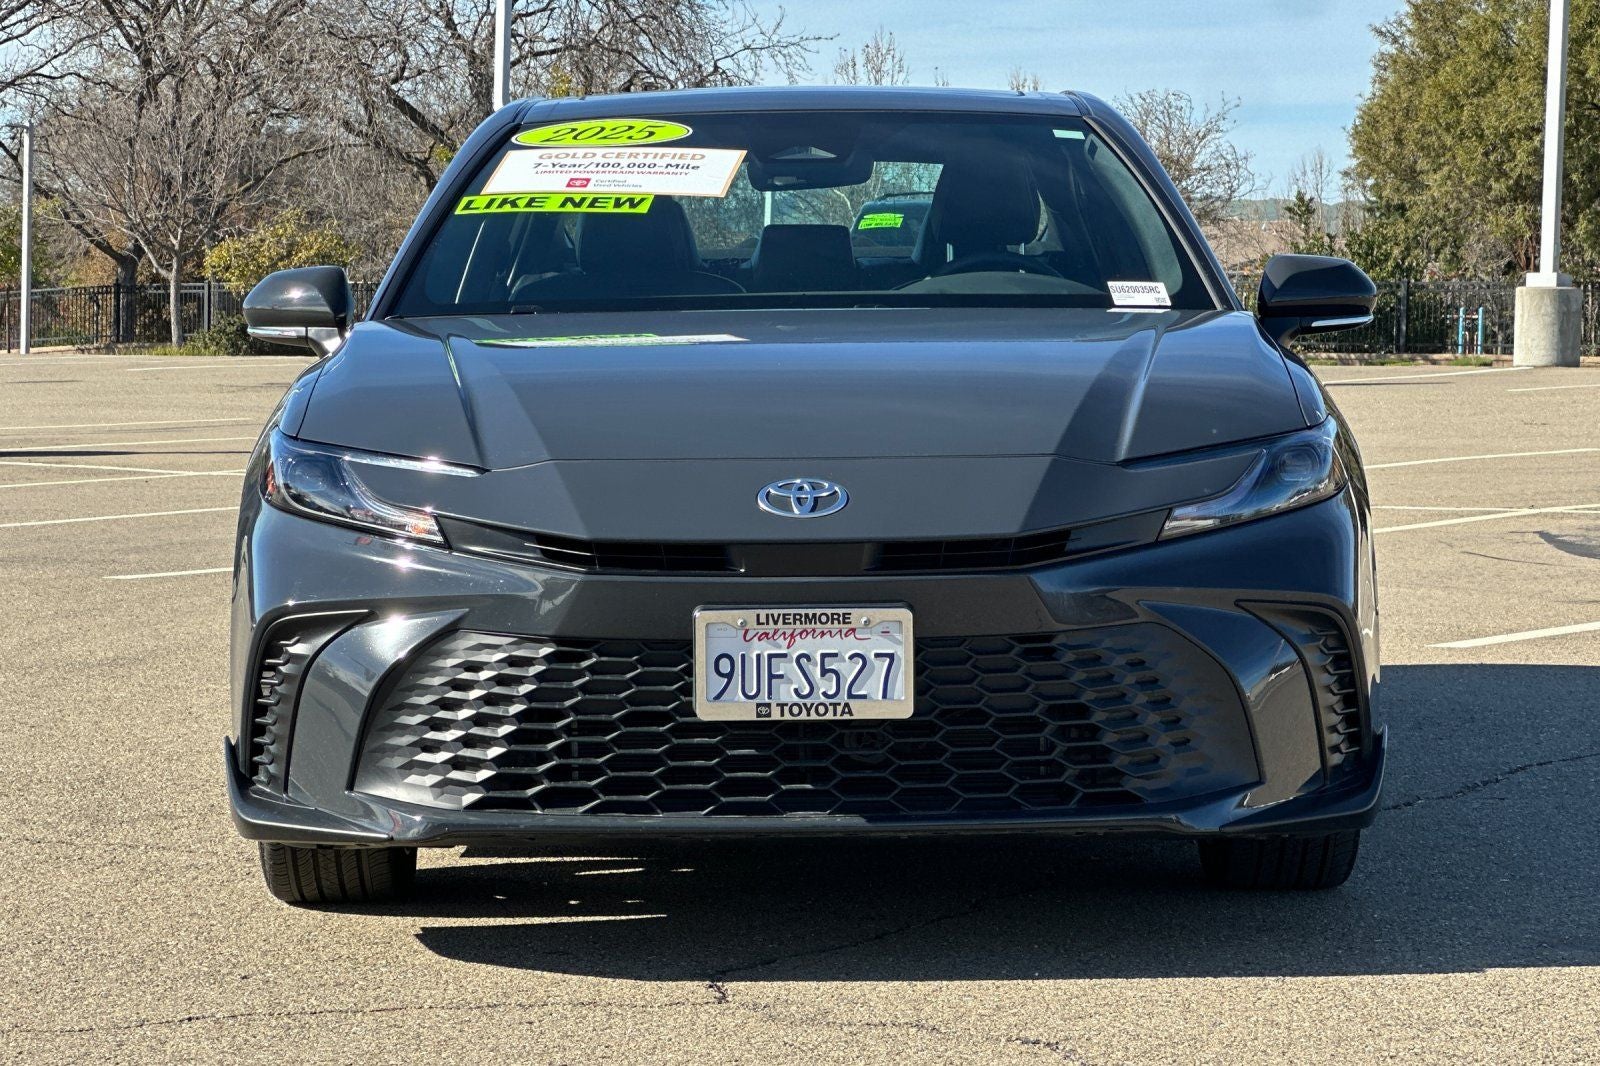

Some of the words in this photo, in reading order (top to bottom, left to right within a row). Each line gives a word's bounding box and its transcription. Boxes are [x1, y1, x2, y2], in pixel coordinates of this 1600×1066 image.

[540, 124, 668, 143] 2025
[538, 152, 597, 160] GOLD
[600, 152, 706, 161] CERTIFIED
[533, 161, 700, 170] 7-Year/100,000-Mile
[460, 196, 551, 211] LIKE
[558, 196, 647, 210] NEW
[1109, 285, 1161, 294] SU620035RC
[755, 612, 852, 626] LIVERMORE
[742, 627, 871, 649] California
[712, 652, 896, 701] 9UFS527
[775, 702, 854, 718] TOYOTA
